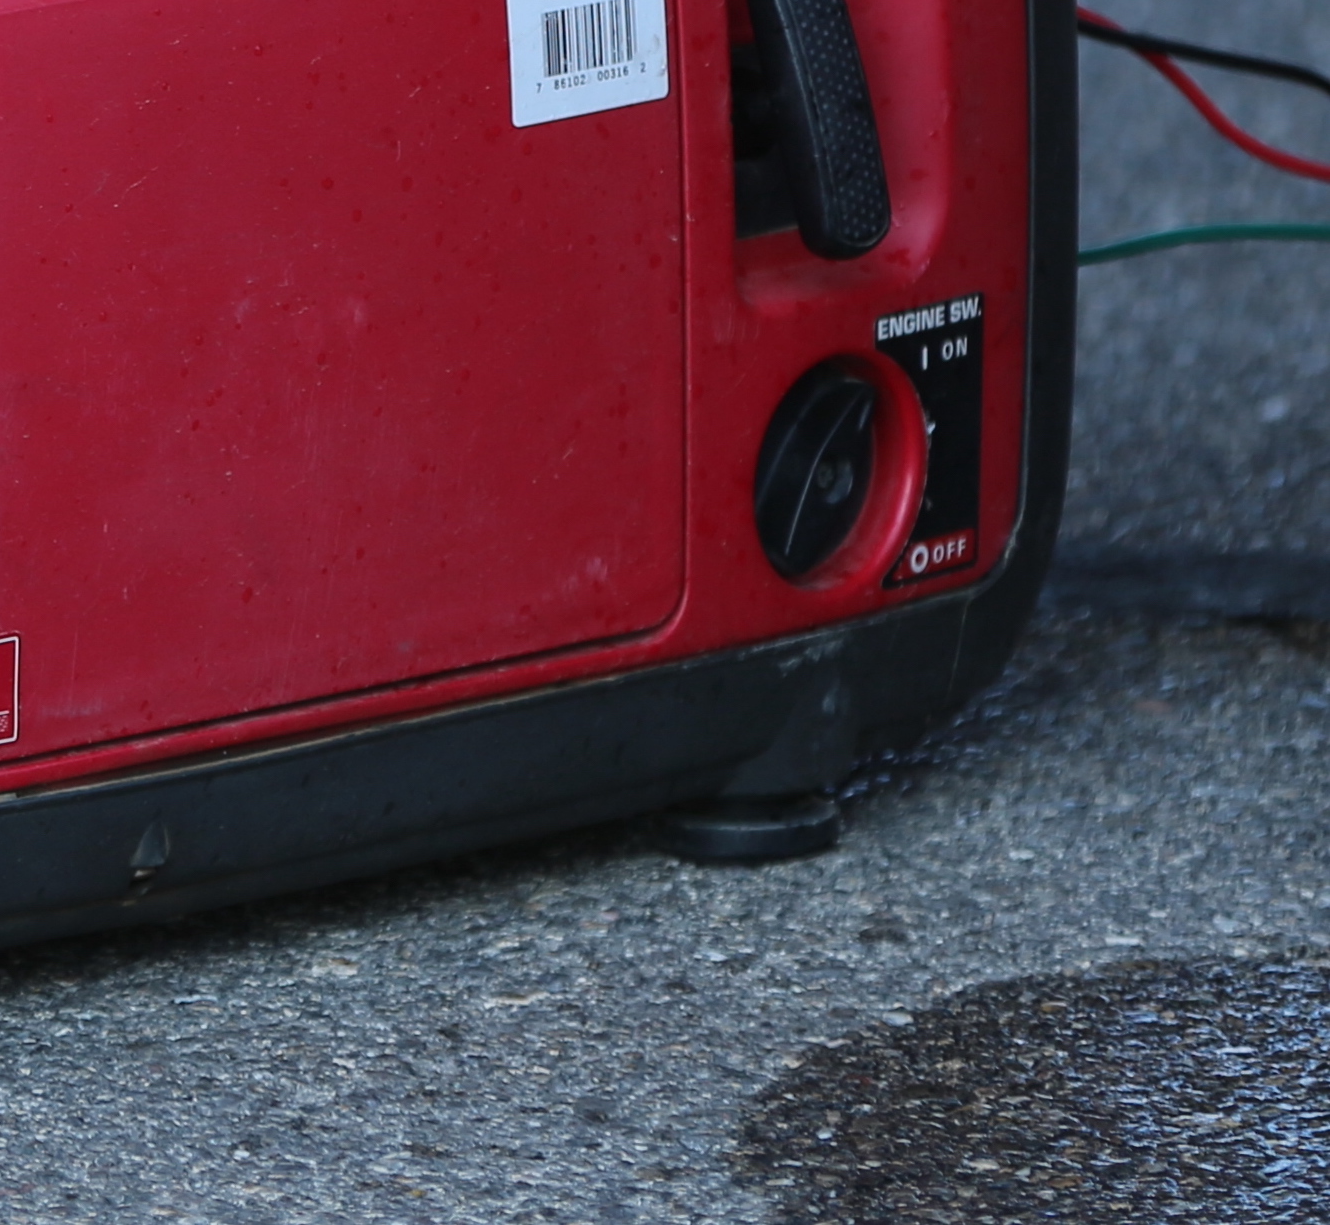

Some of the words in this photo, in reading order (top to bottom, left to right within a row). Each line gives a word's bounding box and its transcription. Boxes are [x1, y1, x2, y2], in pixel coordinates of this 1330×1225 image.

[876, 308, 946, 342] ENGINE
[949, 296, 983, 324] SW.
[942, 337, 969, 362] ON
[933, 538, 967, 563] OFF
